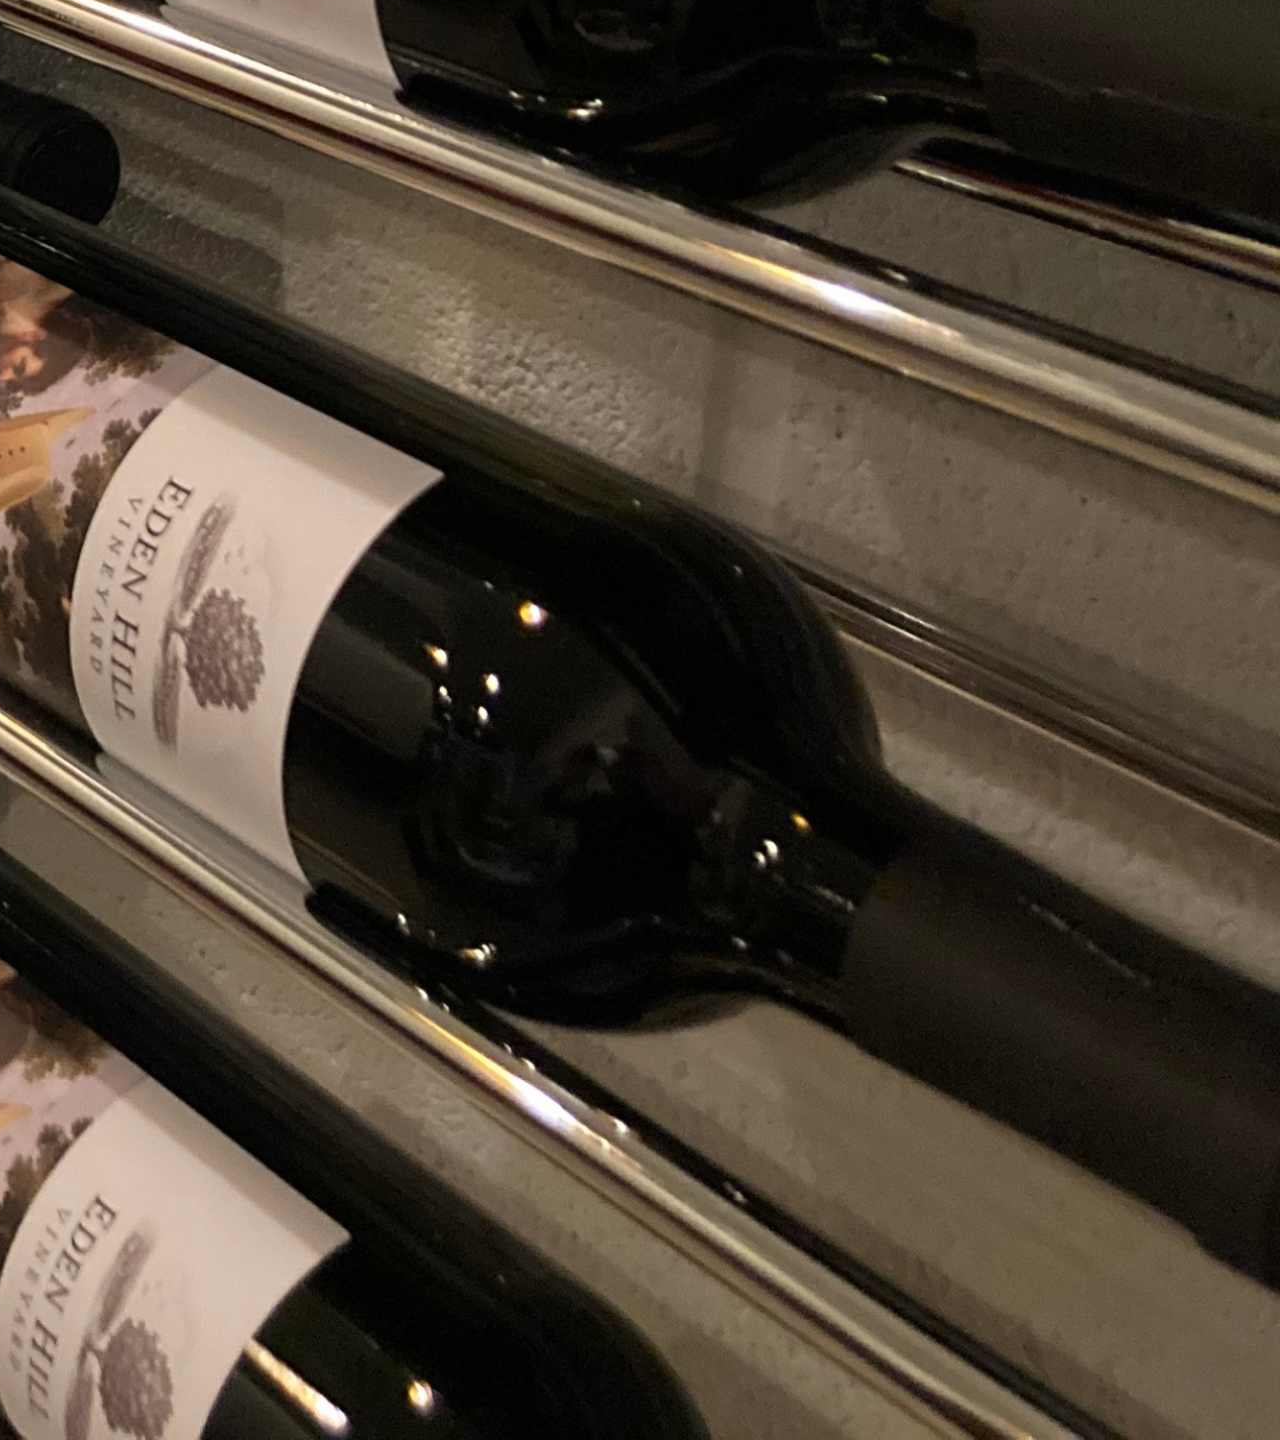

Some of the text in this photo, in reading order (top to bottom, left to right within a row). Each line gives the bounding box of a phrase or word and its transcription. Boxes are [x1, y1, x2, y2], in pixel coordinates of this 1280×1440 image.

[91, 495, 143, 677] VINEYARD
[108, 476, 193, 722] EDEN HILL
[8, 1206, 73, 1372] VINEYARD
[26, 1194, 119, 1420] EDEN HILL
